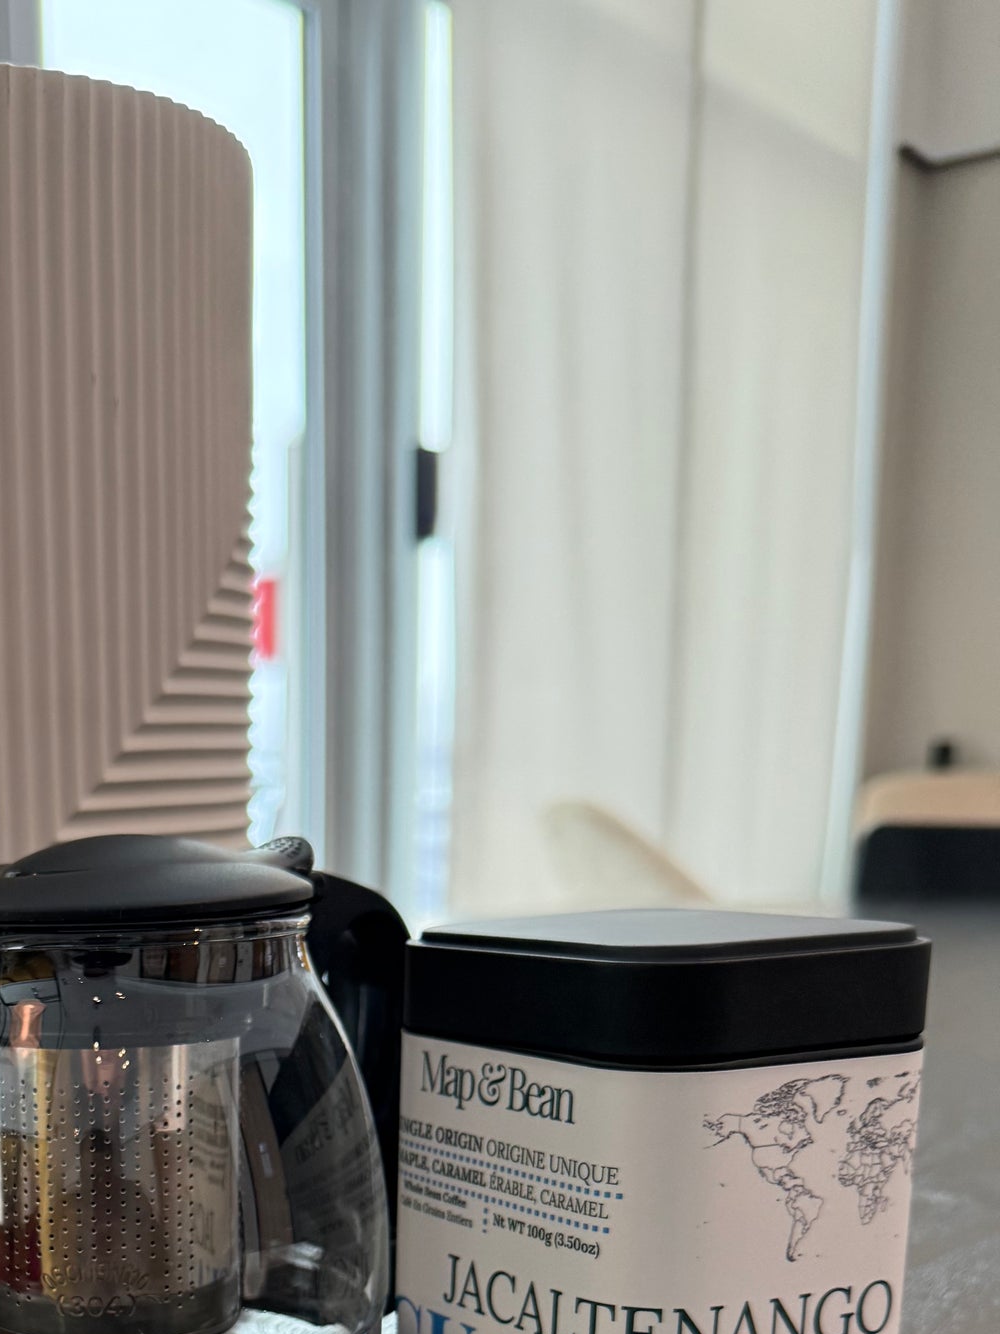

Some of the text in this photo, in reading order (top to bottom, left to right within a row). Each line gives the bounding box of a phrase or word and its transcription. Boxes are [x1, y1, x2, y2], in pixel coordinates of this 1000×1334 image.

[435, 1126, 484, 1153] ORIGIN
[486, 1139, 545, 1170] ORIGINE
[549, 1154, 619, 1186] UNIQUE
[432, 1159, 487, 1188] CARAMEL
[489, 1171, 537, 1205] ÉRABLE,
[540, 1189, 609, 1219] CARAMEL
[443, 1192, 467, 1209] Coffee
[508, 1217, 526, 1235] WT
[527, 1224, 553, 1247] 100g
[554, 1231, 601, 1259] (3.50oz)
